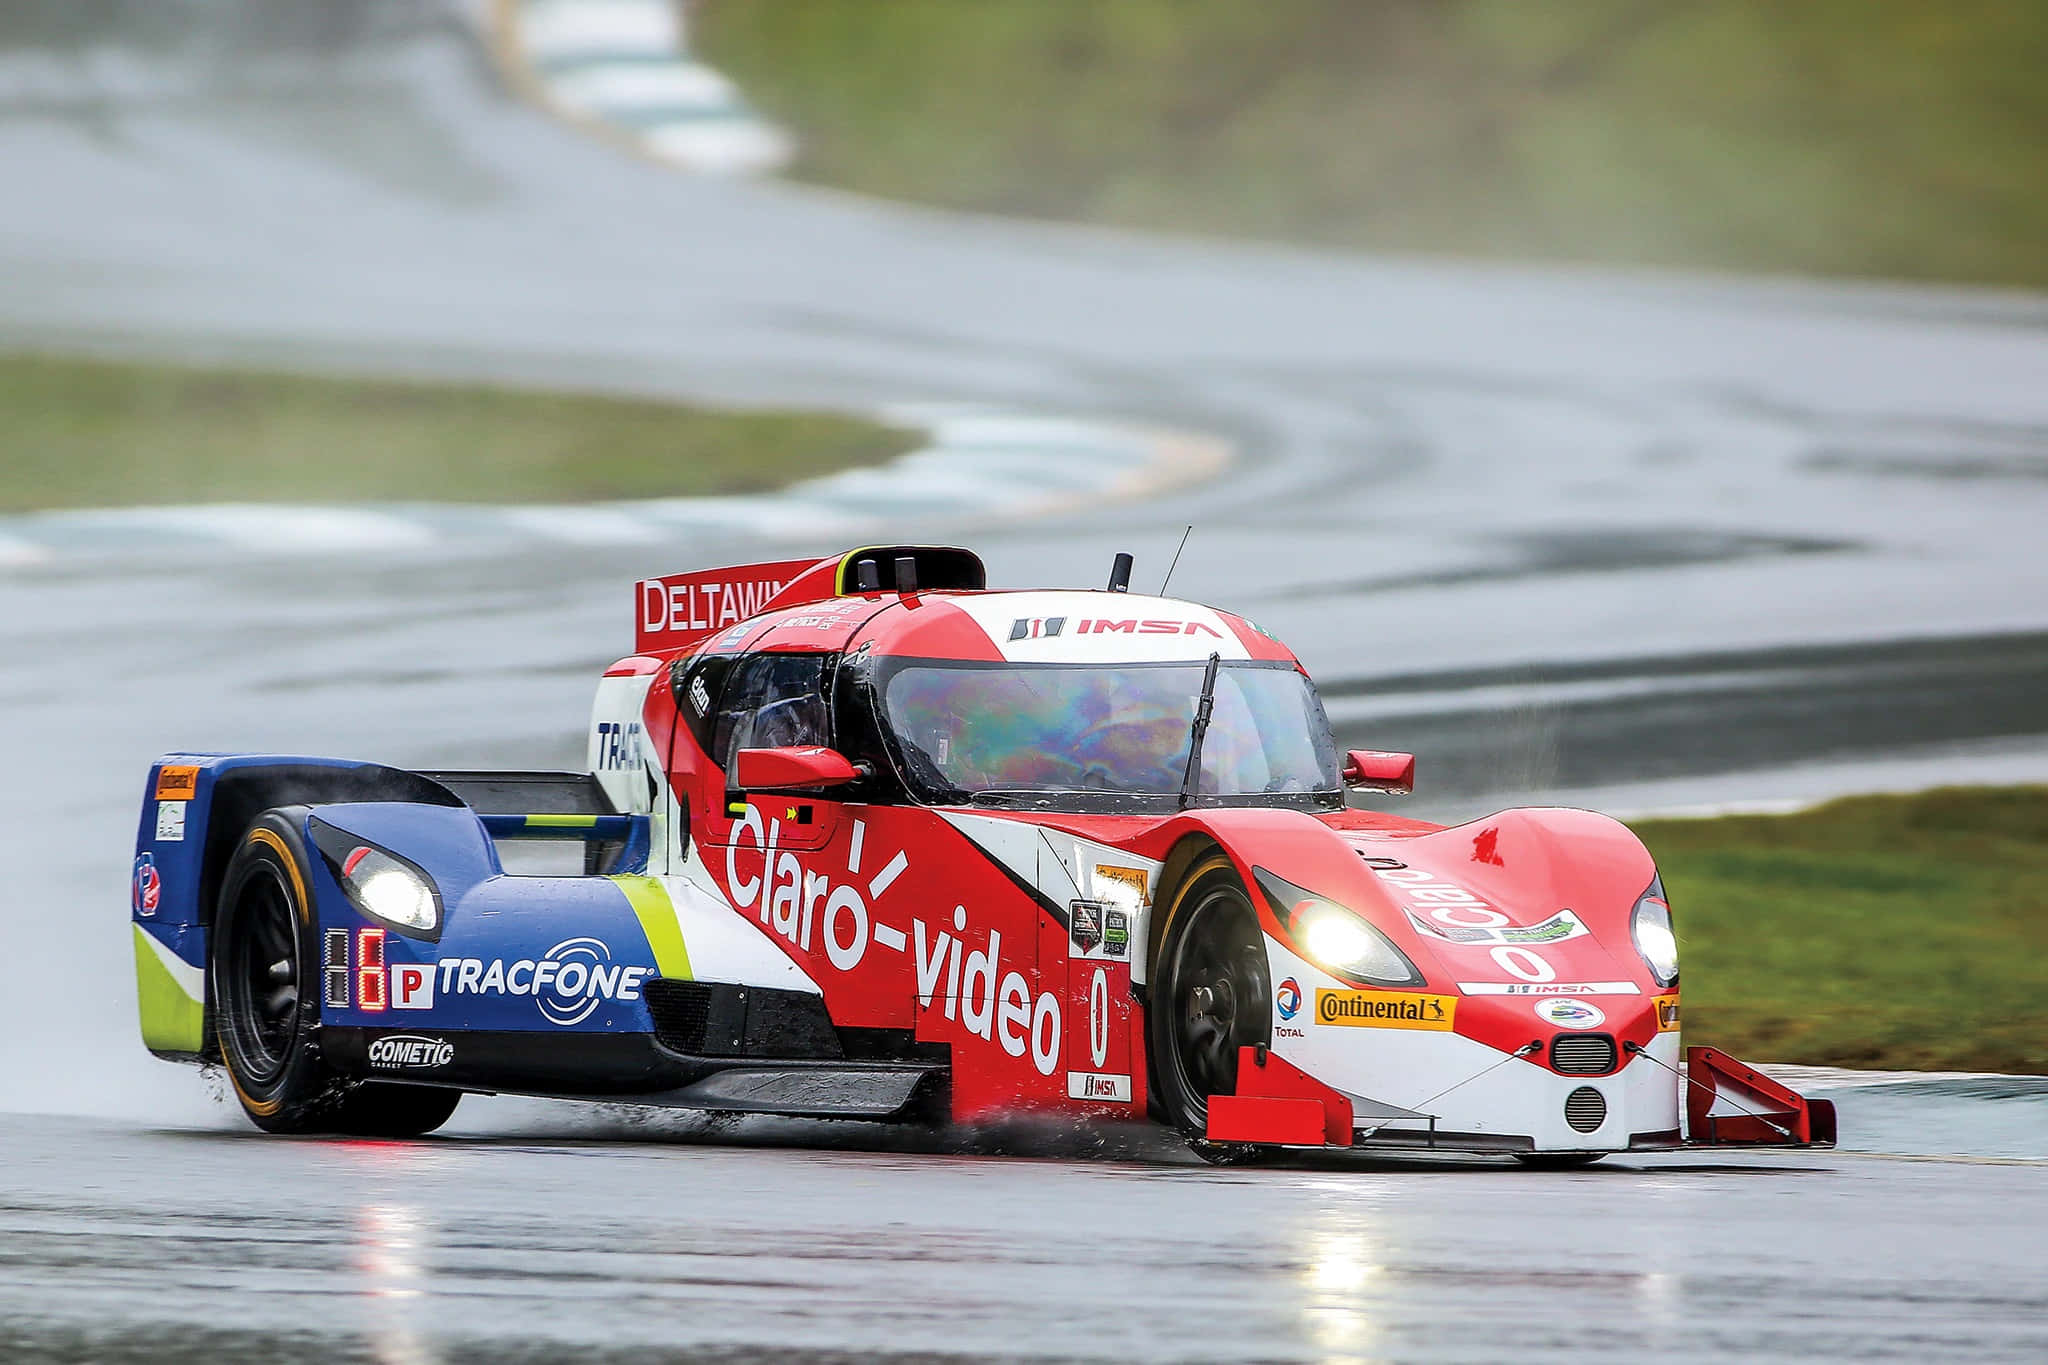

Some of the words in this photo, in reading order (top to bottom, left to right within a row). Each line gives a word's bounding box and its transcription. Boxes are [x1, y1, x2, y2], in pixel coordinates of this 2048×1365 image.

[643, 579, 793, 633] DELTAWI
[1076, 619, 1224, 639] IMSA
[726, 803, 869, 971] Claro
[912, 904, 1061, 1076] video
[439, 957, 647, 1001] TRACFONE
[1535, 985, 1597, 993] IMSA
[1320, 992, 1425, 1022] Continental
[368, 1040, 454, 1065] COMETIC
[1095, 1079, 1118, 1097] IMSA
